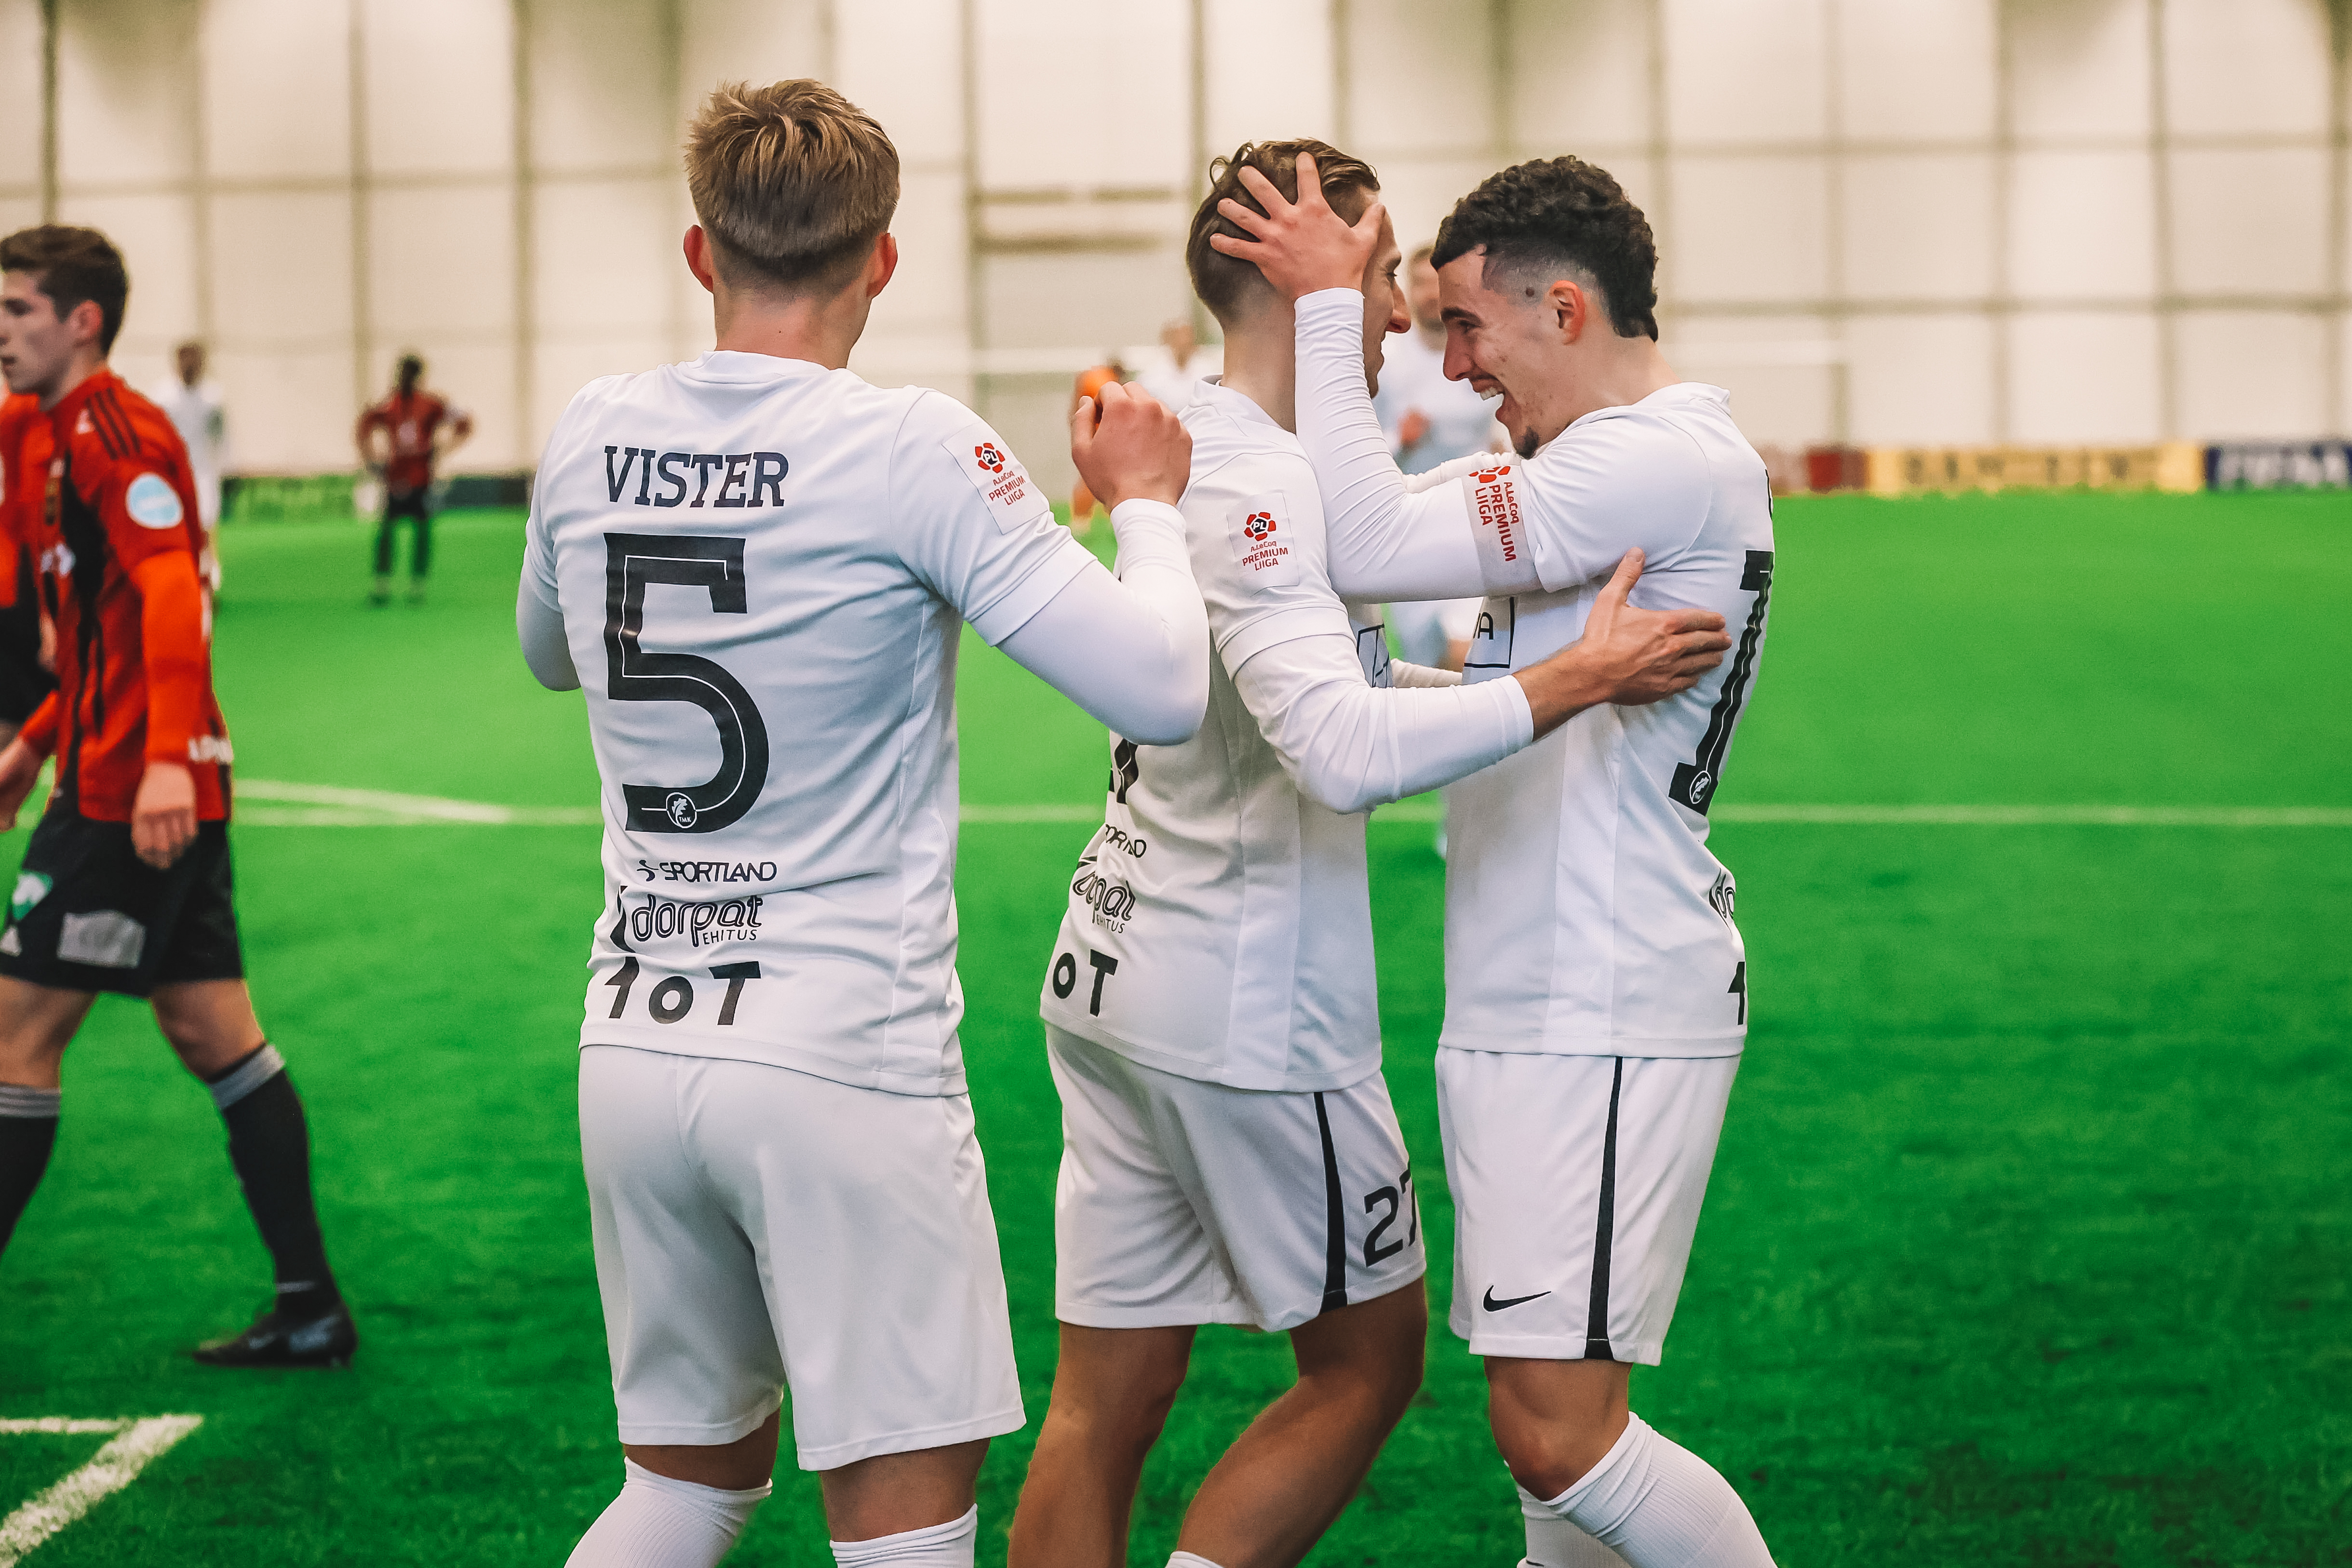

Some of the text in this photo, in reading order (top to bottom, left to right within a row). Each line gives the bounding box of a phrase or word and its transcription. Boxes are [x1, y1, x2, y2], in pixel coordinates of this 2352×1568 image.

[605, 445, 789, 508] VISTER
[988, 475, 1026, 502] PREMIUM
[1004, 488, 1025, 506] LIIGA
[1475, 487, 1493, 526] LIIGA
[1253, 522, 1266, 530] PL
[1489, 484, 1517, 562] PREMIUM
[1242, 547, 1289, 566] PREMIUM
[1254, 558, 1279, 571] LIIGA
[603, 532, 770, 833] 5
[659, 861, 777, 883] SPORTLAND
[631, 893, 764, 948] dorpat
[702, 929, 757, 945] EHITUS
[1052, 947, 1119, 1018] oT
[1363, 1160, 1417, 1268] 27
